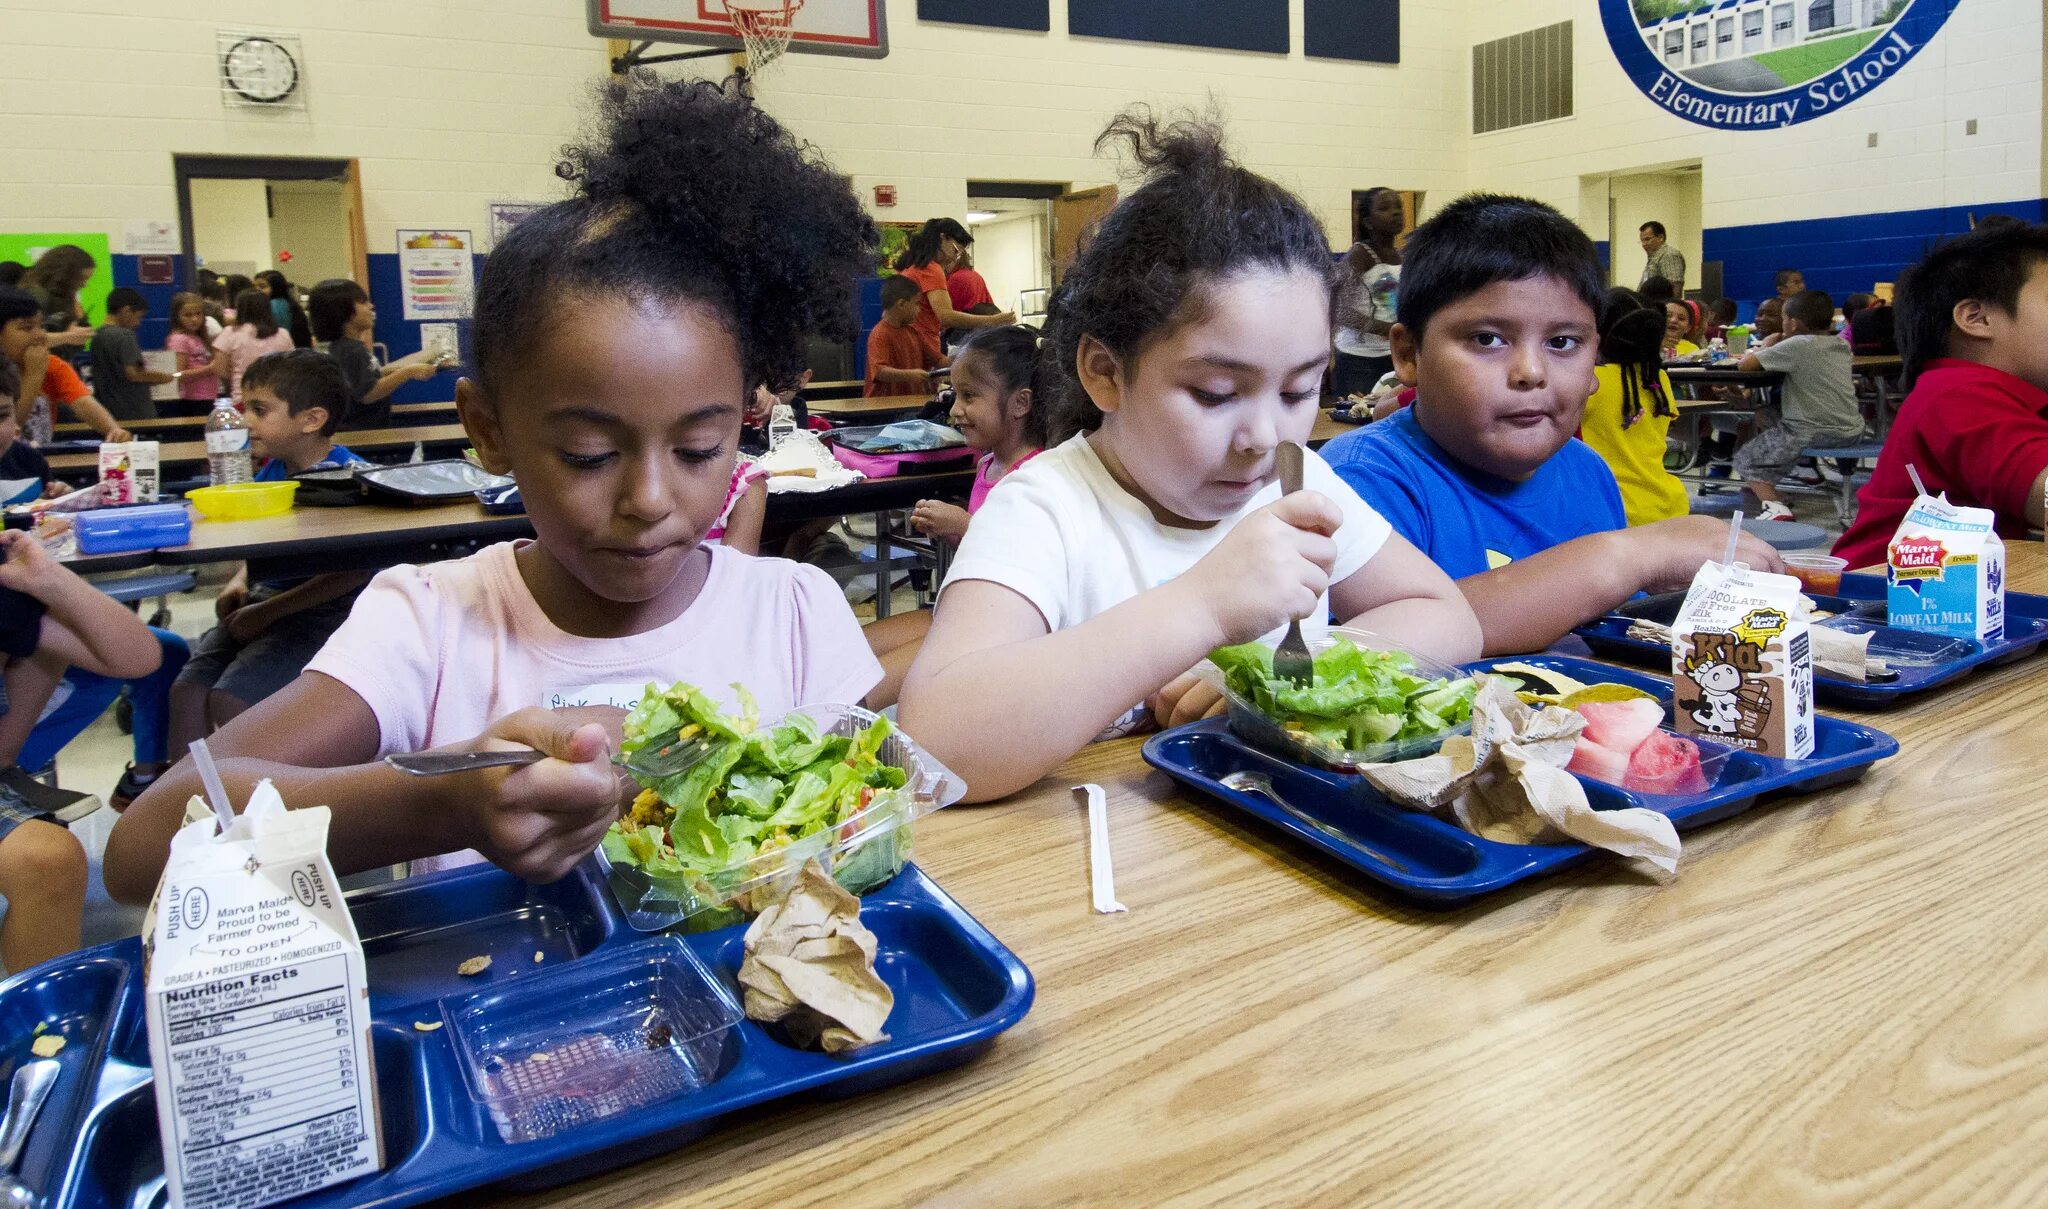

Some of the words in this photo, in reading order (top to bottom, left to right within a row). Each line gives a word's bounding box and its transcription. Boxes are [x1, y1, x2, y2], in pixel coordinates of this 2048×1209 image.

[1648, 71, 1800, 128] Elementary
[1808, 30, 1915, 112] School
[1896, 543, 1939, 554] Marva
[1900, 553, 1934, 566] Maid
[1707, 590, 1767, 606] OCOLATE
[1921, 597, 1938, 611] 1%
[1889, 612, 1940, 625] LOWFAT
[1941, 610, 1973, 624] MILK
[1693, 625, 1727, 633] Healthy
[1691, 632, 1762, 672] Kid
[1698, 733, 1757, 748] CHOCOLATE
[170, 885, 181, 903] UP
[297, 877, 311, 901] HERE
[308, 863, 324, 893] PUSH
[320, 893, 332, 909] UP
[190, 895, 201, 923] HERE
[216, 904, 254, 919] Marva
[167, 905, 180, 939] PUSH
[217, 914, 256, 930] Proud
[259, 912, 272, 922] to
[275, 908, 290, 919] be
[207, 930, 253, 944] Farmer
[256, 917, 300, 934] Owned
[219, 948, 241, 958] TO
[246, 936, 292, 954] OPEN
[164, 971, 199, 987] GRADE
[198, 970, 203, 979] A
[212, 955, 271, 976] PASTEURIZED
[280, 941, 343, 961] HOMOGENIZED
[166, 980, 244, 1003] Nutrition
[250, 969, 298, 986] Facts
[199, 998, 215, 1006] Size
[224, 991, 241, 1000] Cup
[203, 1005, 217, 1013] Per
[219, 997, 256, 1009] Container
[273, 1007, 303, 1020] Calories
[306, 1002, 325, 1013] from
[327, 998, 339, 1008] Fat
[308, 1013, 324, 1021] Daily
[335, 1017, 348, 1026] 0%
[336, 1027, 349, 1037] 0%
[339, 1048, 351, 1058] 1%
[200, 1094, 255, 1112] Carbohydrate
